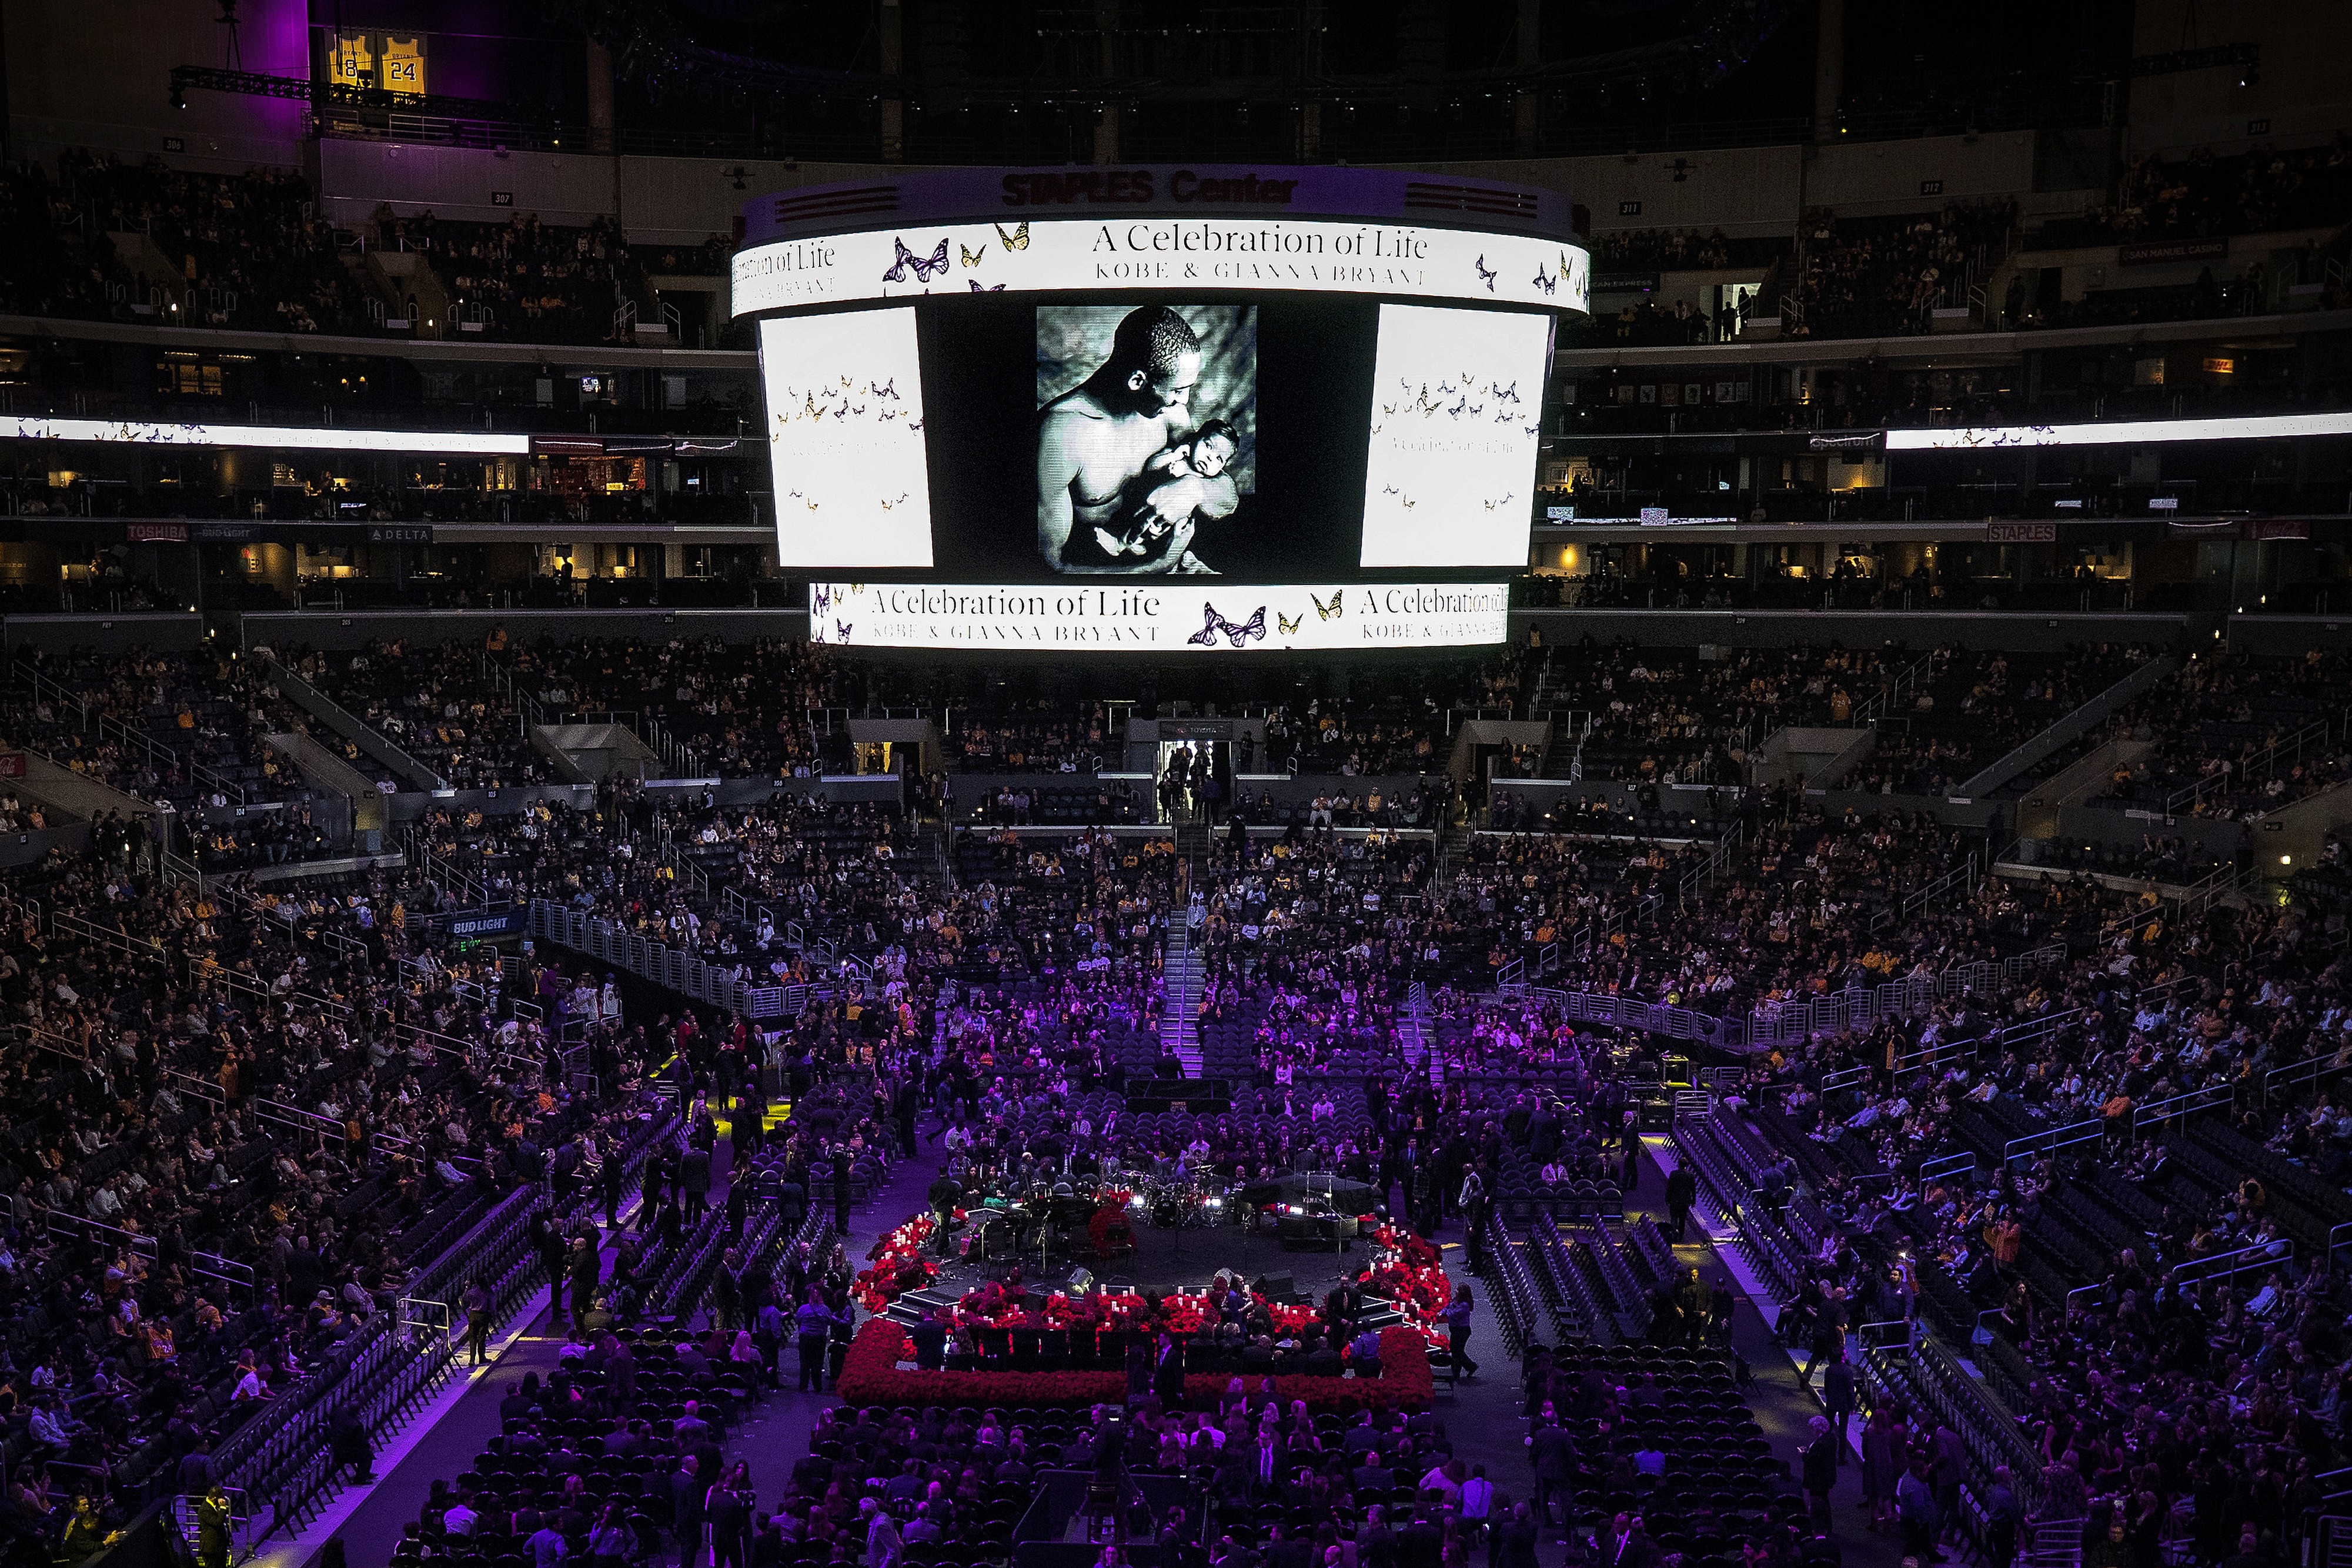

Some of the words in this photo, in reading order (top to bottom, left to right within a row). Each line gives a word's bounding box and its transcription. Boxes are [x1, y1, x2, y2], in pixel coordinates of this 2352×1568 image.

[346, 59, 356, 78] 8
[391, 62, 416, 82] 24
[167, 140, 181, 149] 306
[1001, 170, 1153, 205] STAPLES
[1170, 170, 1298, 203] Center
[1925, 183, 1940, 192] 312
[495, 194, 510, 203] 307
[1622, 204, 1637, 213] 311
[1093, 225, 1117, 252] A
[1127, 223, 1324, 254] Celebration
[1335, 227, 1367, 256] of
[1375, 229, 1428, 259] Life
[797, 240, 835, 270] Life
[2130, 250, 2148, 259] SAN
[2149, 248, 2186, 258] MANUEL
[2189, 244, 2223, 254] CASINO
[1095, 262, 1168, 279] KOBE
[1184, 263, 1199, 279] &
[1215, 262, 1320, 280] GIANNA
[1332, 265, 1426, 286] BRYANT
[128, 525, 188, 538] TOSHIBA
[386, 530, 428, 540] DELTA
[1990, 525, 2054, 540] STAPLES
[872, 589, 885, 614] A
[891, 589, 1045, 616] Celebration
[1057, 589, 1089, 616] of
[1099, 589, 1160, 616] Life
[1359, 590, 1378, 614] A
[1386, 587, 1488, 614] Celebration
[874, 623, 918, 638] KOBE
[951, 625, 1041, 641] GIANNA
[1057, 626, 1160, 642] BRYANT
[1363, 623, 1414, 639] KOBE
[236, 807, 245, 816] 104
[454, 921, 476, 934] BUD
[477, 917, 508, 931] LIGHT
